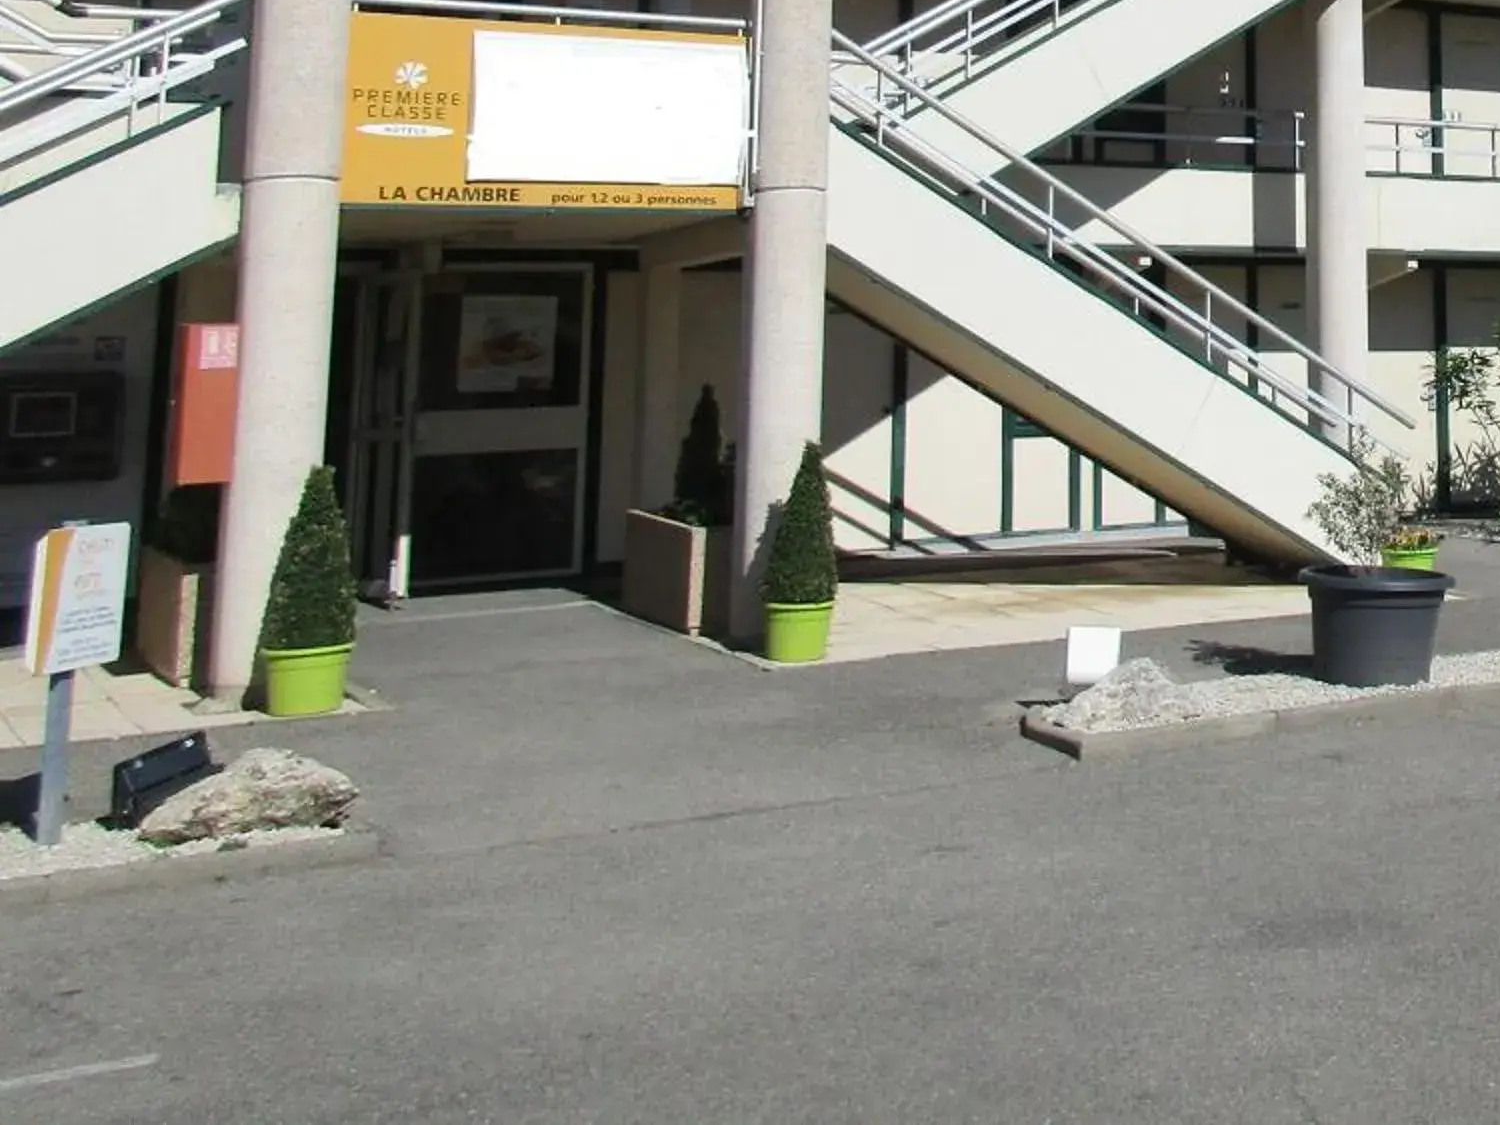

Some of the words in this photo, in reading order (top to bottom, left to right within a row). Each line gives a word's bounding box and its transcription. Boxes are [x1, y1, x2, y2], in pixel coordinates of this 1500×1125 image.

[352, 88, 462, 106] PREMIERE
[366, 104, 448, 120] CLASSE
[378, 186, 407, 200] LA
[415, 186, 521, 202] CHAMBRE
[551, 193, 585, 204] pour
[612, 193, 631, 204] ou
[636, 193, 644, 204] 3
[647, 194, 718, 206] personnes
